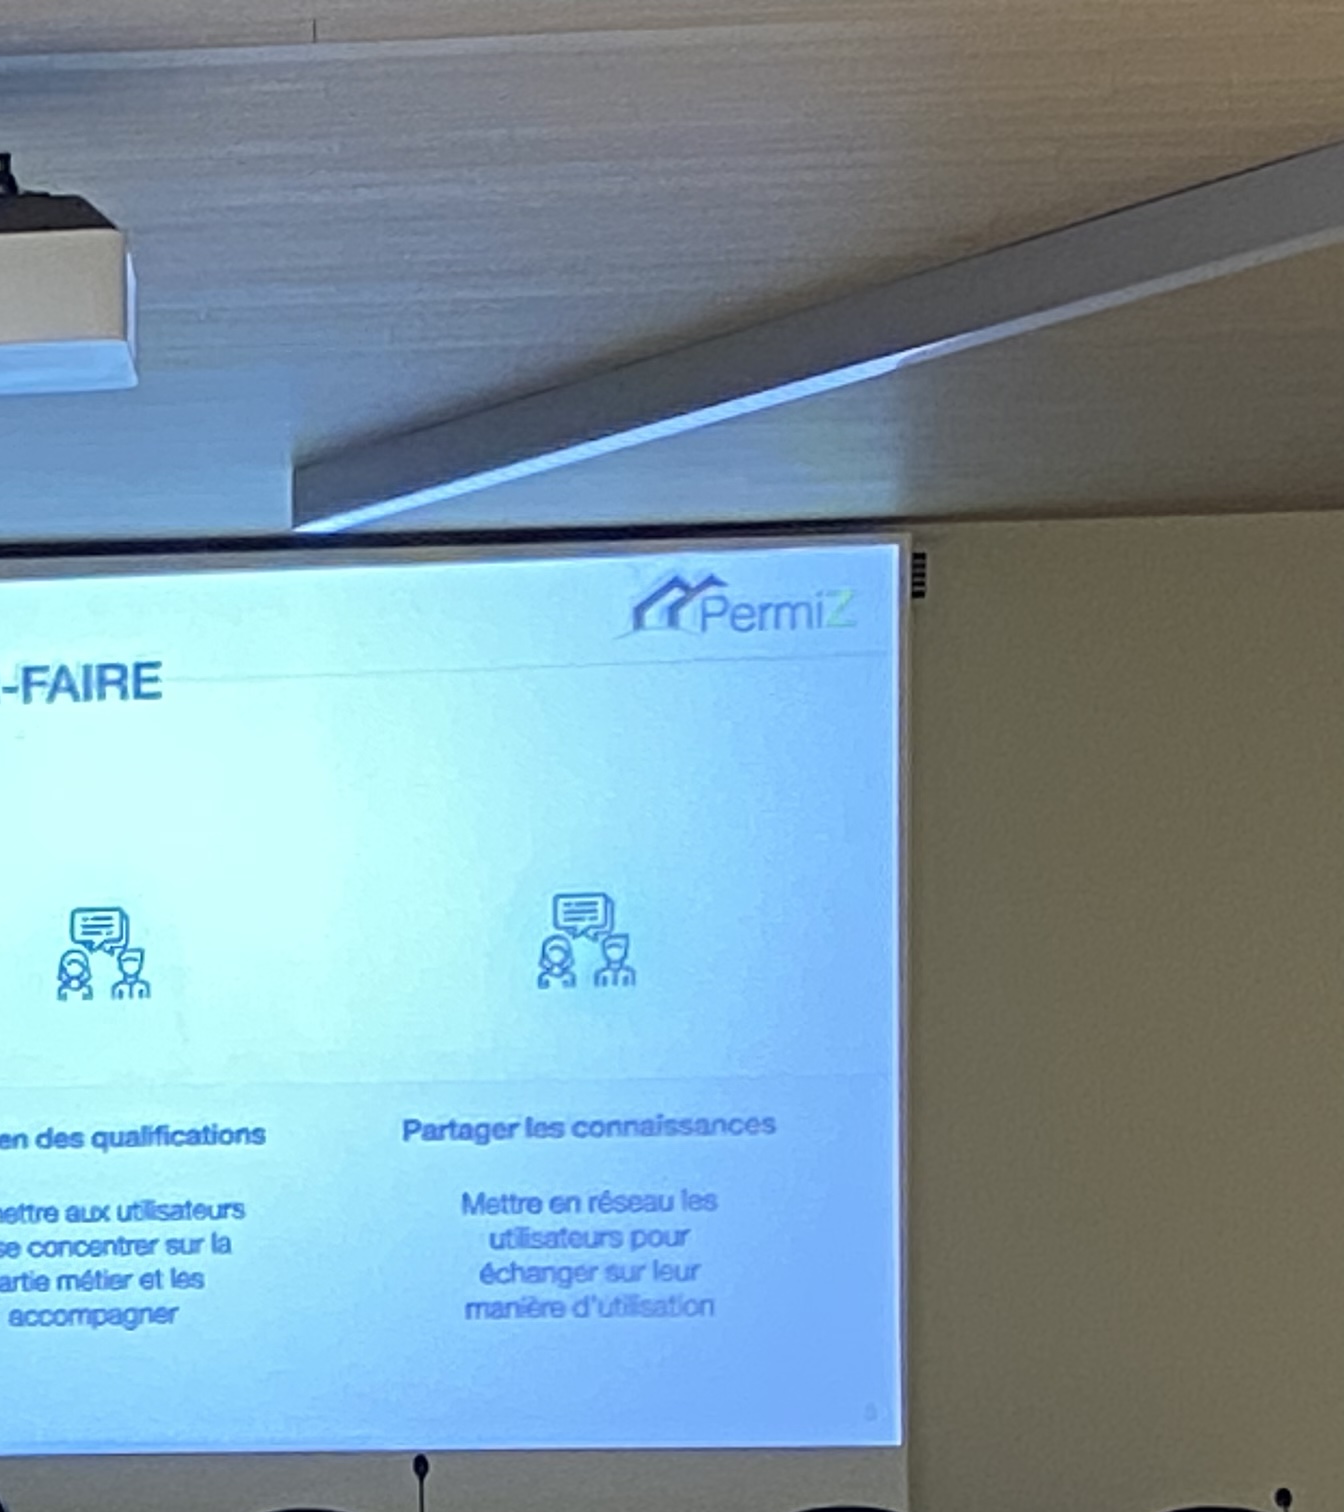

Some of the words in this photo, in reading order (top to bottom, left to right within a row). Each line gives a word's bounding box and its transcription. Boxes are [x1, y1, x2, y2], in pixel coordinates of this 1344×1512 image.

[701, 588, 857, 633] PermiZ
[35, 1126, 84, 1150] des
[91, 1123, 267, 1152] qualifications
[402, 1118, 520, 1145] Partager
[525, 1115, 565, 1139] les
[571, 1113, 777, 1139] connaissances
[65, 1204, 110, 1223] aux
[117, 1199, 246, 1222] utilisateurs
[461, 1191, 543, 1216] Mettre
[548, 1196, 581, 1215] en
[588, 1190, 674, 1213] réseau
[681, 1188, 718, 1212] les
[27, 1236, 159, 1258] concentrer
[165, 1237, 205, 1256] sur
[211, 1231, 232, 1255] la
[489, 1226, 624, 1250] utilisateurs
[630, 1227, 691, 1252] pour
[57, 1268, 133, 1292] métier
[139, 1269, 164, 1291] et
[170, 1267, 205, 1290] les
[479, 1260, 599, 1289] échanger
[605, 1262, 646, 1283] sur
[652, 1259, 702, 1282] leur
[9, 1304, 179, 1331] accompagner
[464, 1294, 566, 1320] manière
[572, 1293, 716, 1319] d'utilisation
